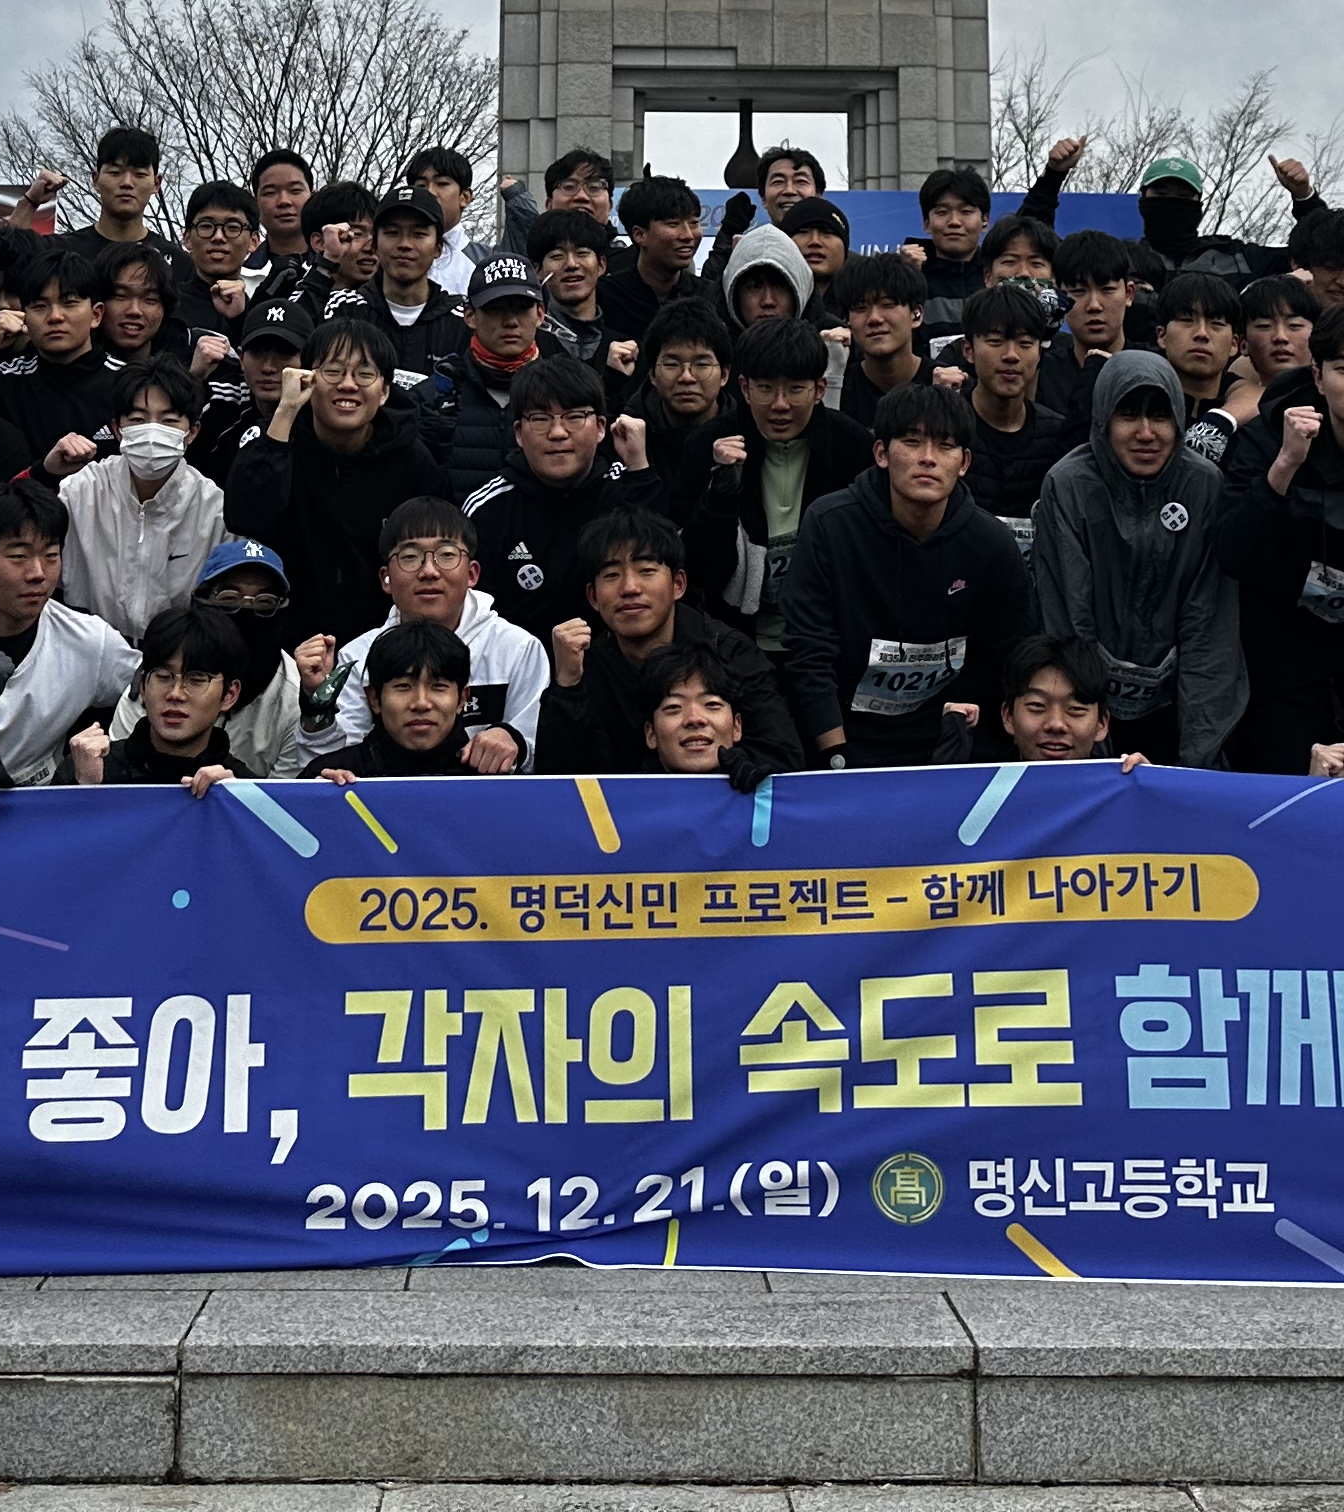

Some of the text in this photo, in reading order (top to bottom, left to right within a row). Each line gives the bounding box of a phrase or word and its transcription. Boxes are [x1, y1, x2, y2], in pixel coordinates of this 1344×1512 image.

[483, 257, 527, 276] PEARLY
[484, 268, 528, 285] GATES
[360, 888, 488, 932] 2025.
[510, 882, 678, 934] 명덕신민
[699, 878, 875, 926] 프로젝트
[920, 867, 1006, 921] 함께
[1027, 862, 1202, 914] 나아가기
[21, 993, 299, 1165] 좋아,
[344, 985, 694, 1131] 각자의
[739, 968, 1084, 1114] 속도로
[305, 1179, 506, 1230] 2025.
[526, 1176, 615, 1232] 12.
[968, 1157, 1276, 1220] 명신고등학교
